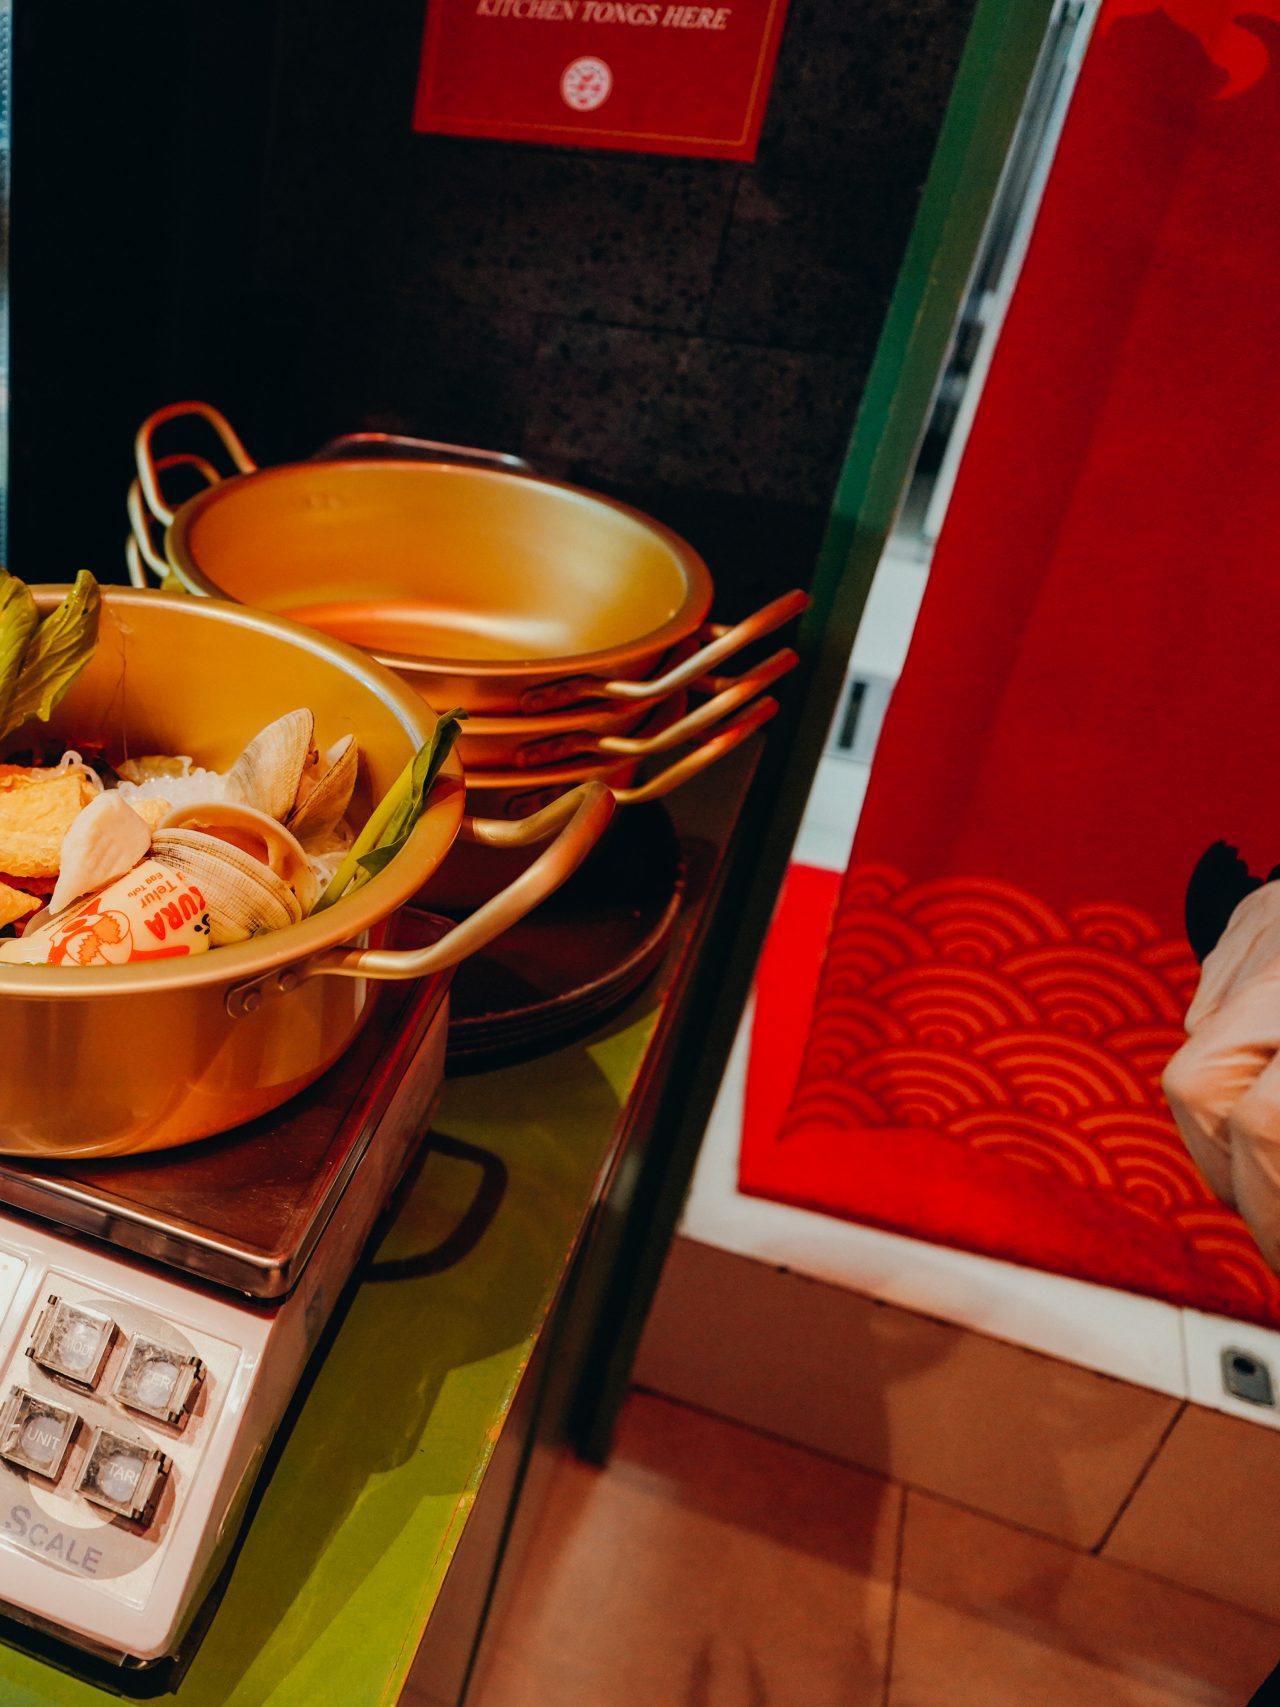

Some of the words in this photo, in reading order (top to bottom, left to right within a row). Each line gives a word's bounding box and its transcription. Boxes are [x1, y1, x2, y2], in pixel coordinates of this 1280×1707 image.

[476, 0, 577, 21] KITCHEN
[582, 1, 662, 26] TONGS
[662, 6, 732, 30] HERE
[127, 884, 147, 898] Tofu
[144, 872, 164, 885] Egg
[140, 879, 178, 909] Telur
[26, 1426, 61, 1450] UNIT
[4, 1504, 103, 1574] SCALE
